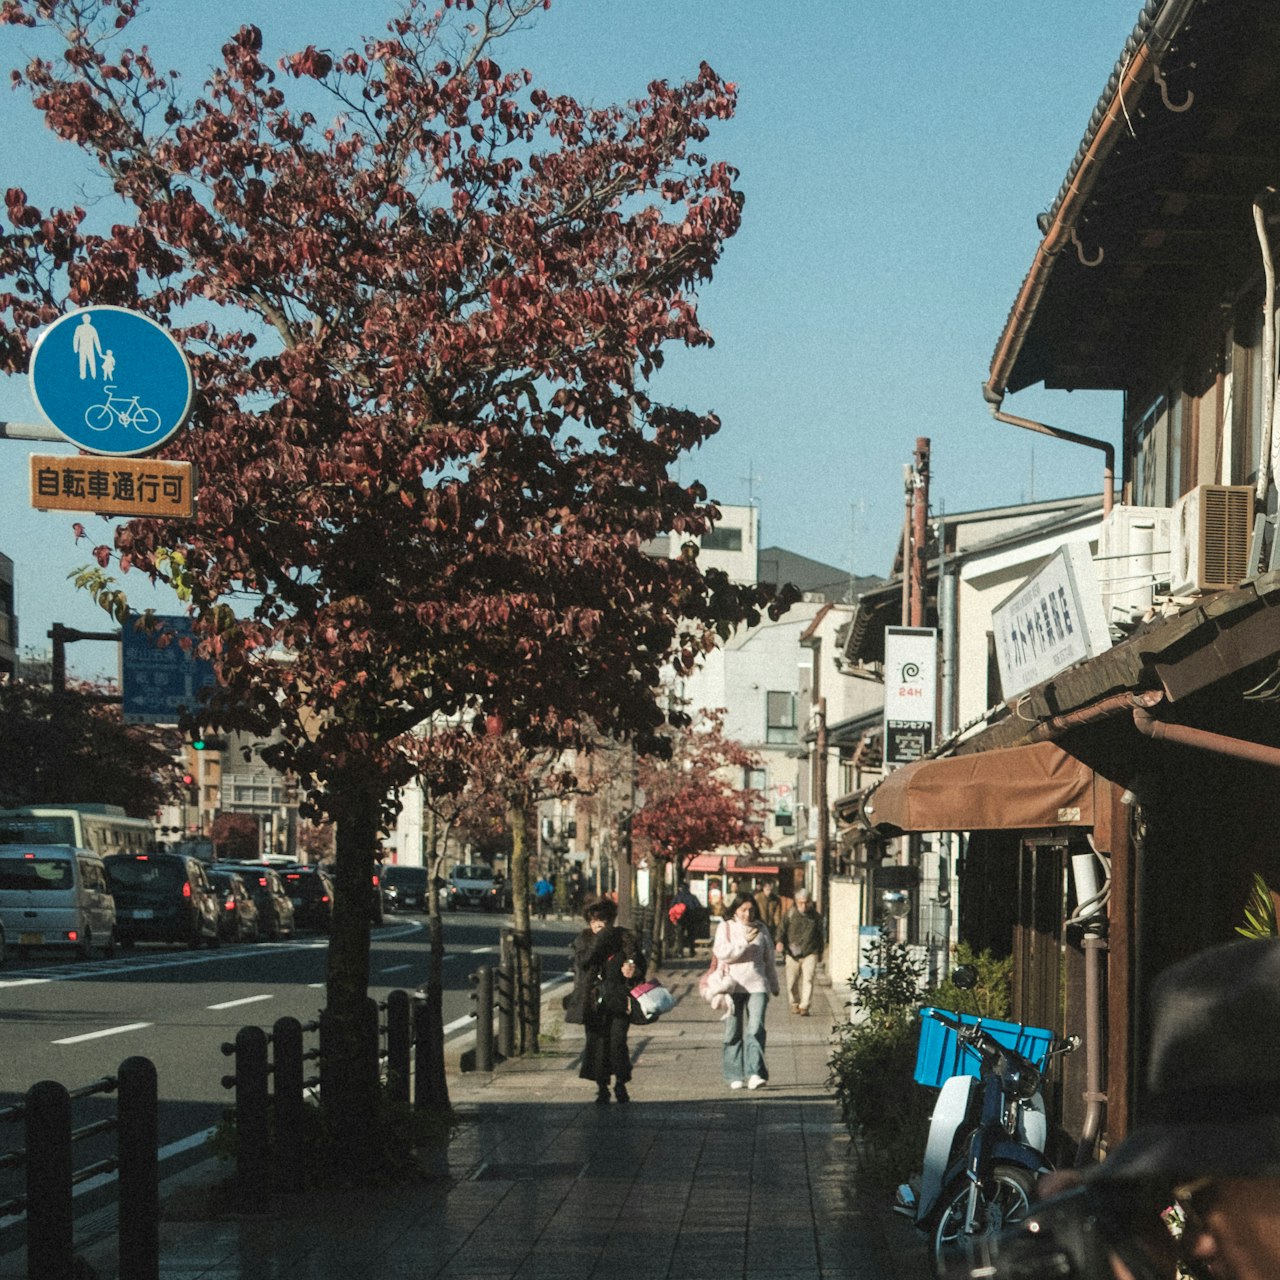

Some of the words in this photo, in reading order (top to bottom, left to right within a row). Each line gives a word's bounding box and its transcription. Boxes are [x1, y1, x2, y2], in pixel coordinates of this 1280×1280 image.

[38, 466, 184, 504] 自転車通行可
[898, 687, 923, 697] 24H
